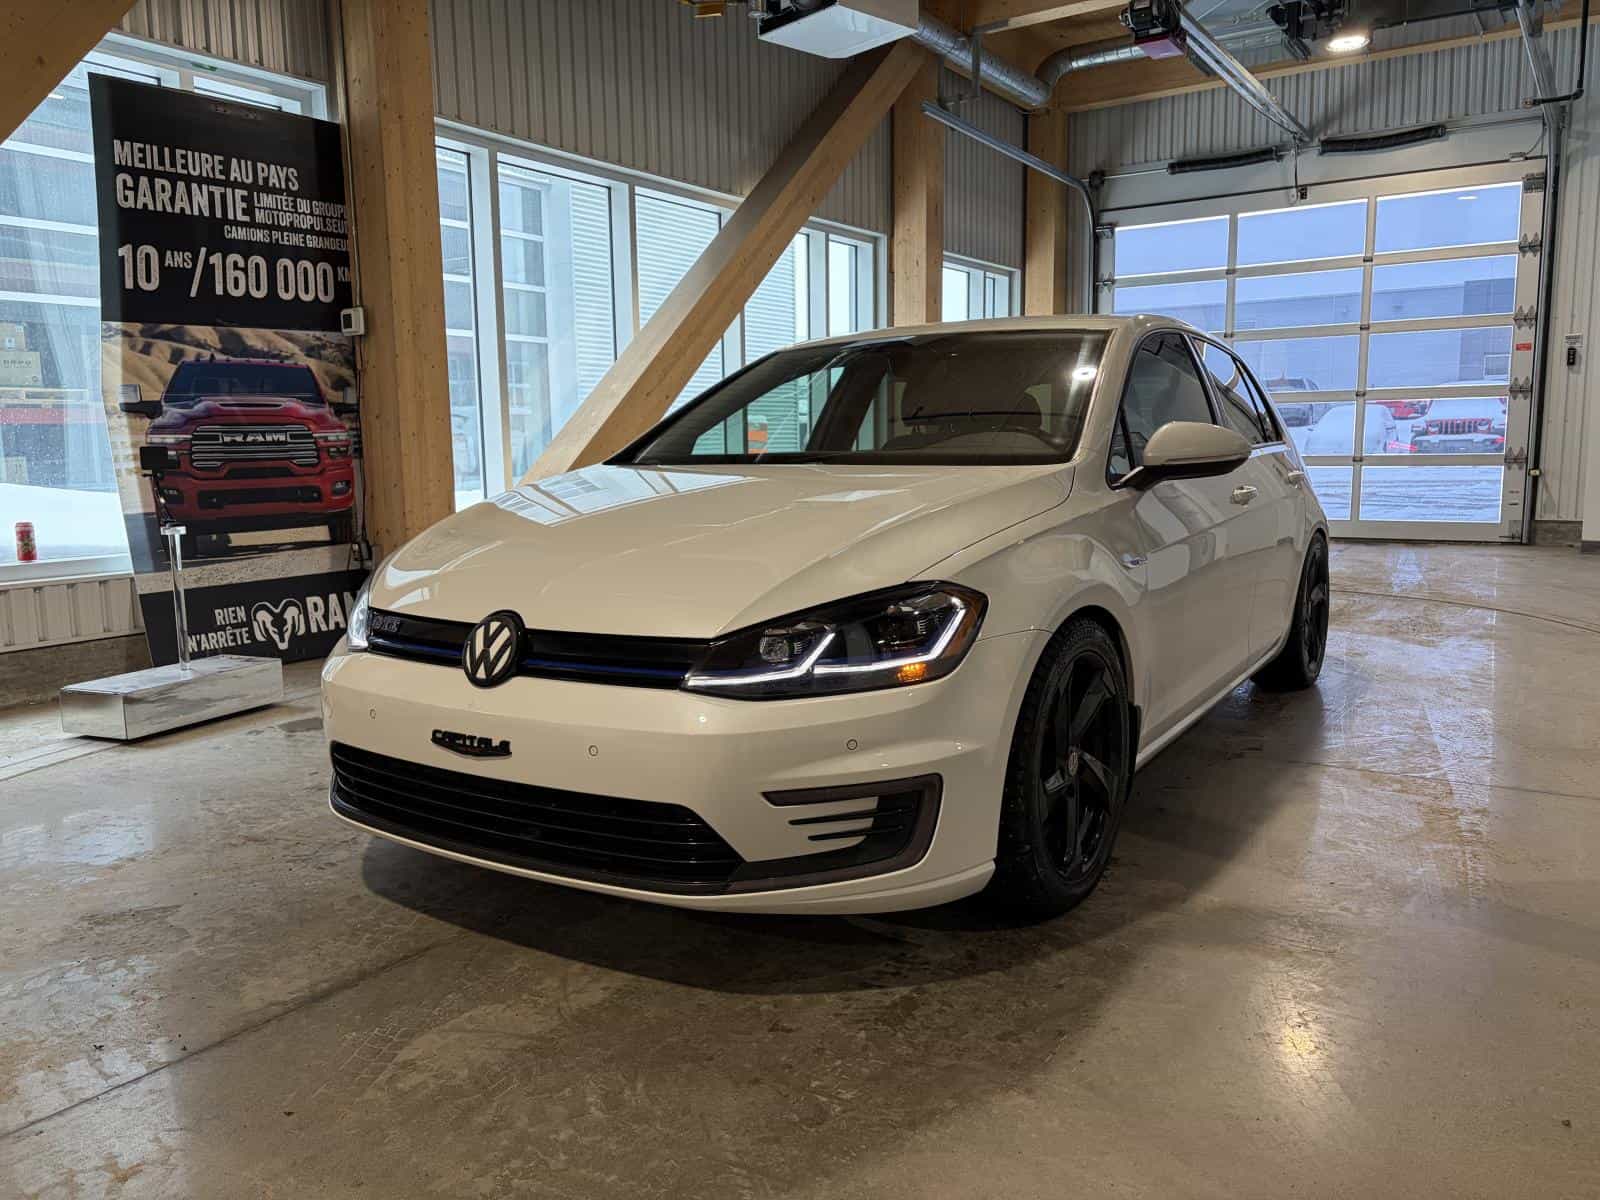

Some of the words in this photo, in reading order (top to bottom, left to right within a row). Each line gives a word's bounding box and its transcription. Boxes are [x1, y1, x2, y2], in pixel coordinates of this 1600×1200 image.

[114, 139, 225, 181] MEILLEURE
[230, 157, 253, 184] AU
[257, 161, 299, 192] PAYS
[116, 172, 250, 222] GARANTIE
[254, 191, 296, 212] LIMITÉE
[297, 198, 311, 214] DU
[255, 207, 348, 234] MOTOPROPULSEU
[224, 225, 271, 243] CAMIONS
[272, 230, 305, 247] PLEINE
[306, 234, 349, 251] GRANDEU
[118, 243, 160, 291] 10
[276, 258, 335, 303] 000
[223, 431, 287, 443] RAM
[214, 605, 247, 626] RIEN
[187, 627, 251, 653] N'ARRÊTE
